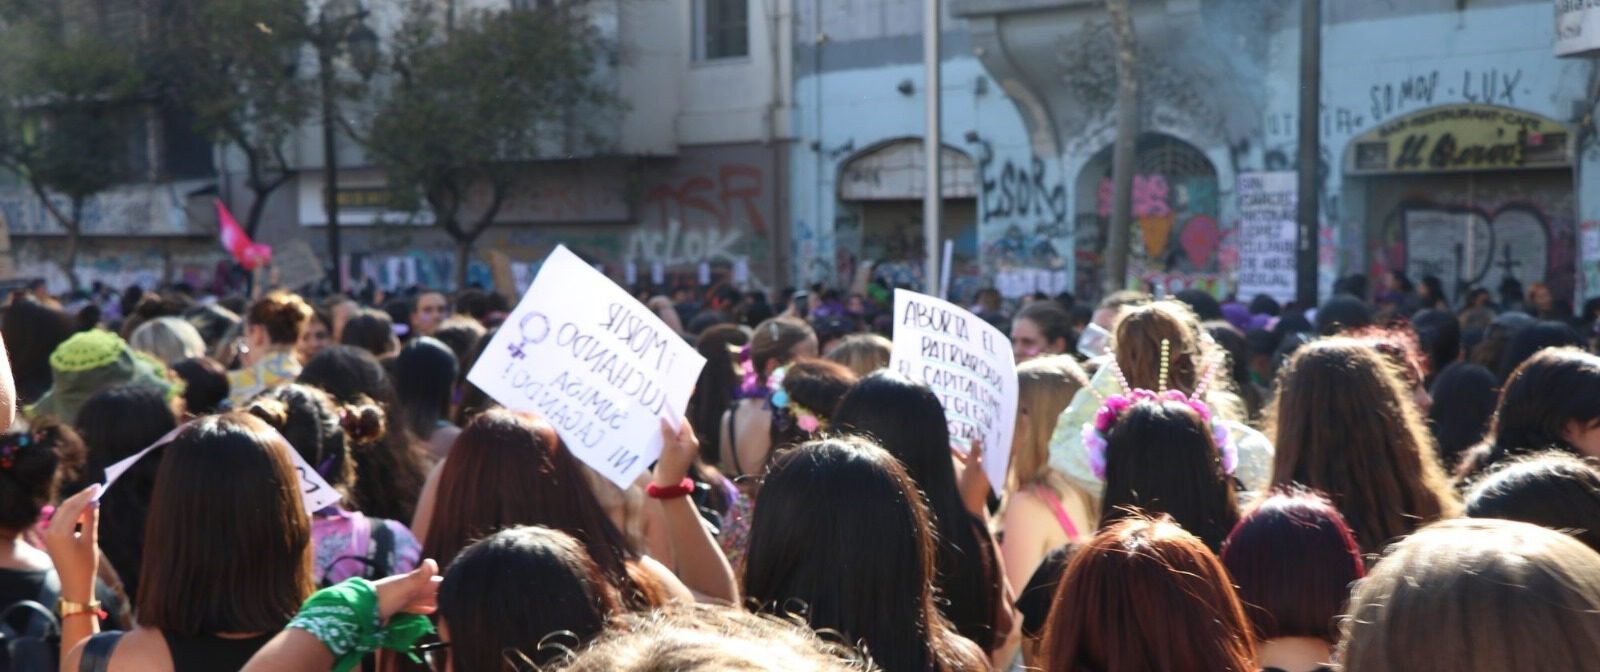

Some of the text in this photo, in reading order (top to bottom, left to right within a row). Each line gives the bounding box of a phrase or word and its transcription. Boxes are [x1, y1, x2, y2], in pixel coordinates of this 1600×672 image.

[1462, 68, 1524, 105] LUX
[903, 300, 997, 355] ABORTA EL
